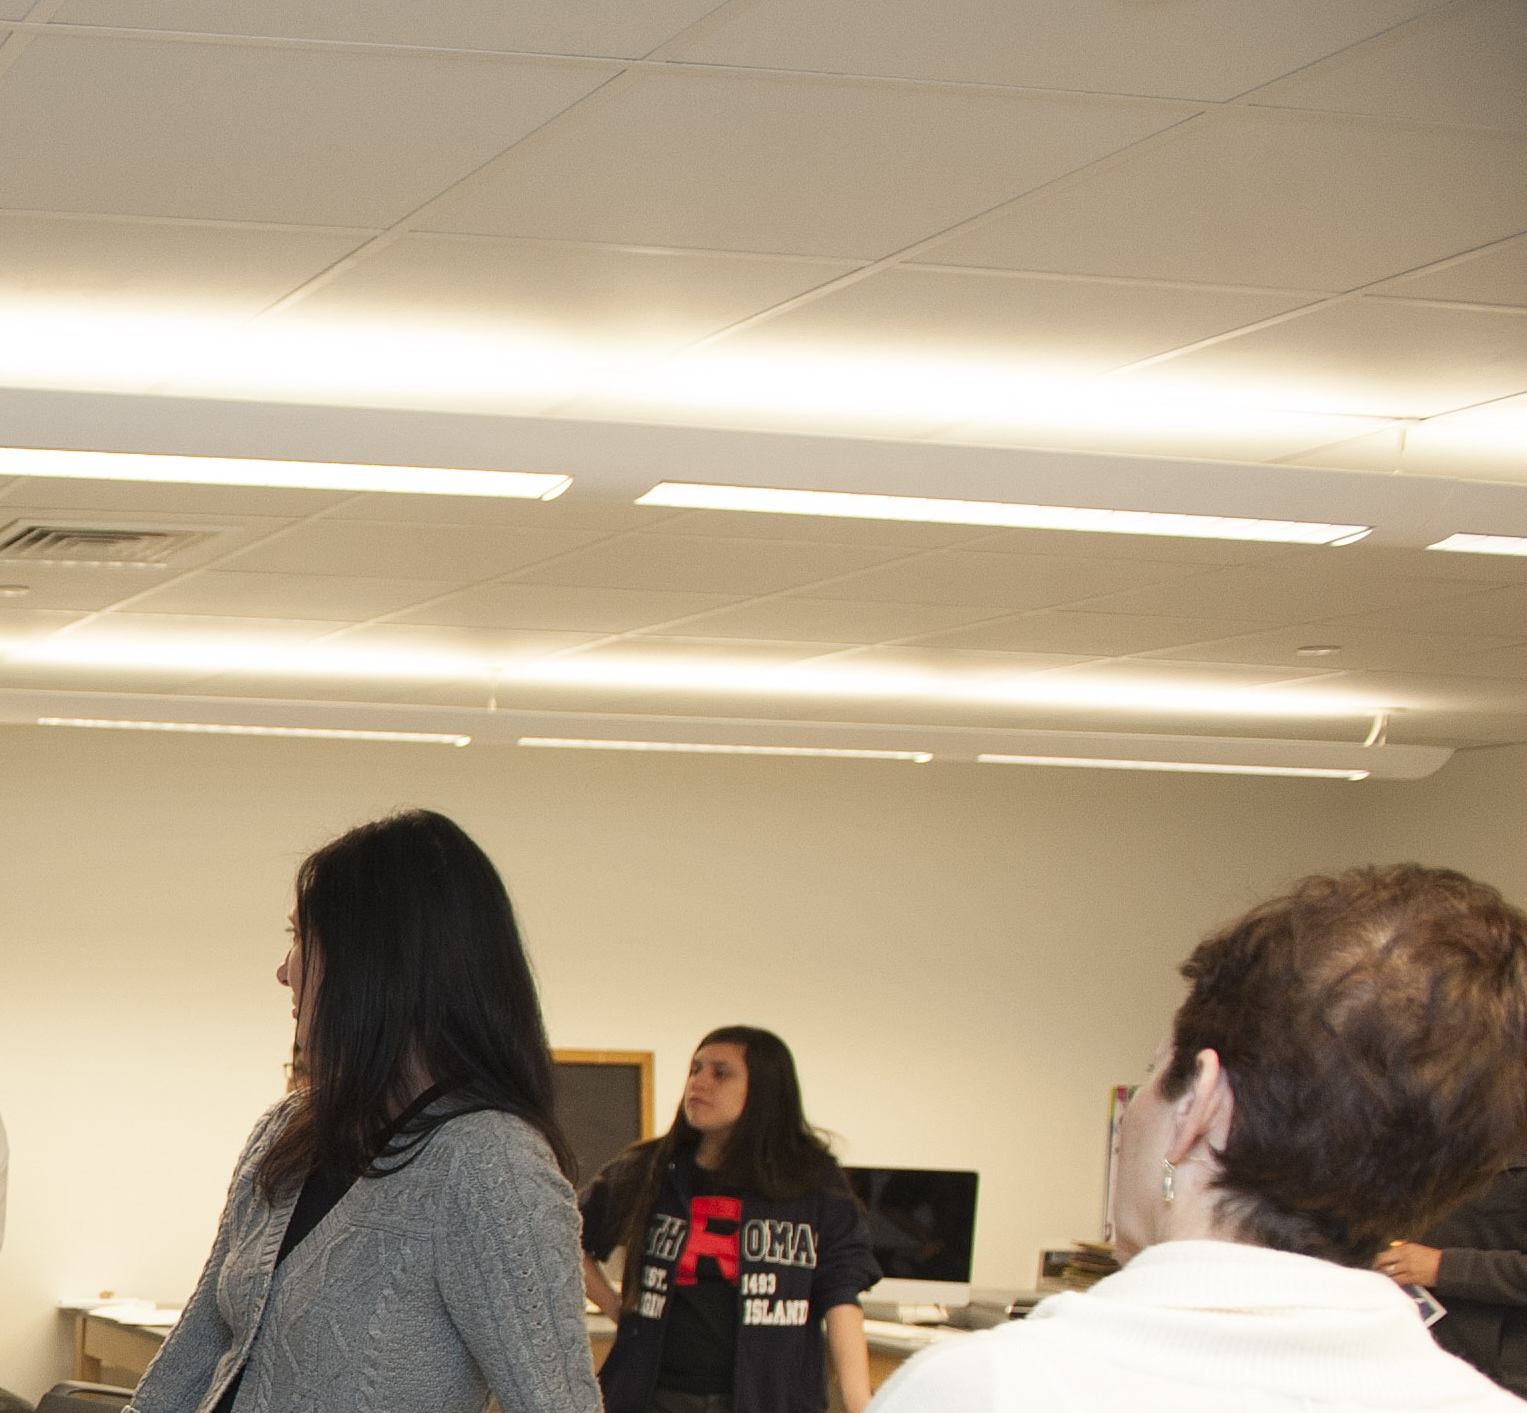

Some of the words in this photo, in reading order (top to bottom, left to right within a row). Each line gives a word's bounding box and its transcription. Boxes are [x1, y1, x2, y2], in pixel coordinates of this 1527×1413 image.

[743, 1219, 818, 1269] OMA
[742, 1272, 777, 1296] 1493
[742, 1298, 810, 1326] ISLAND
